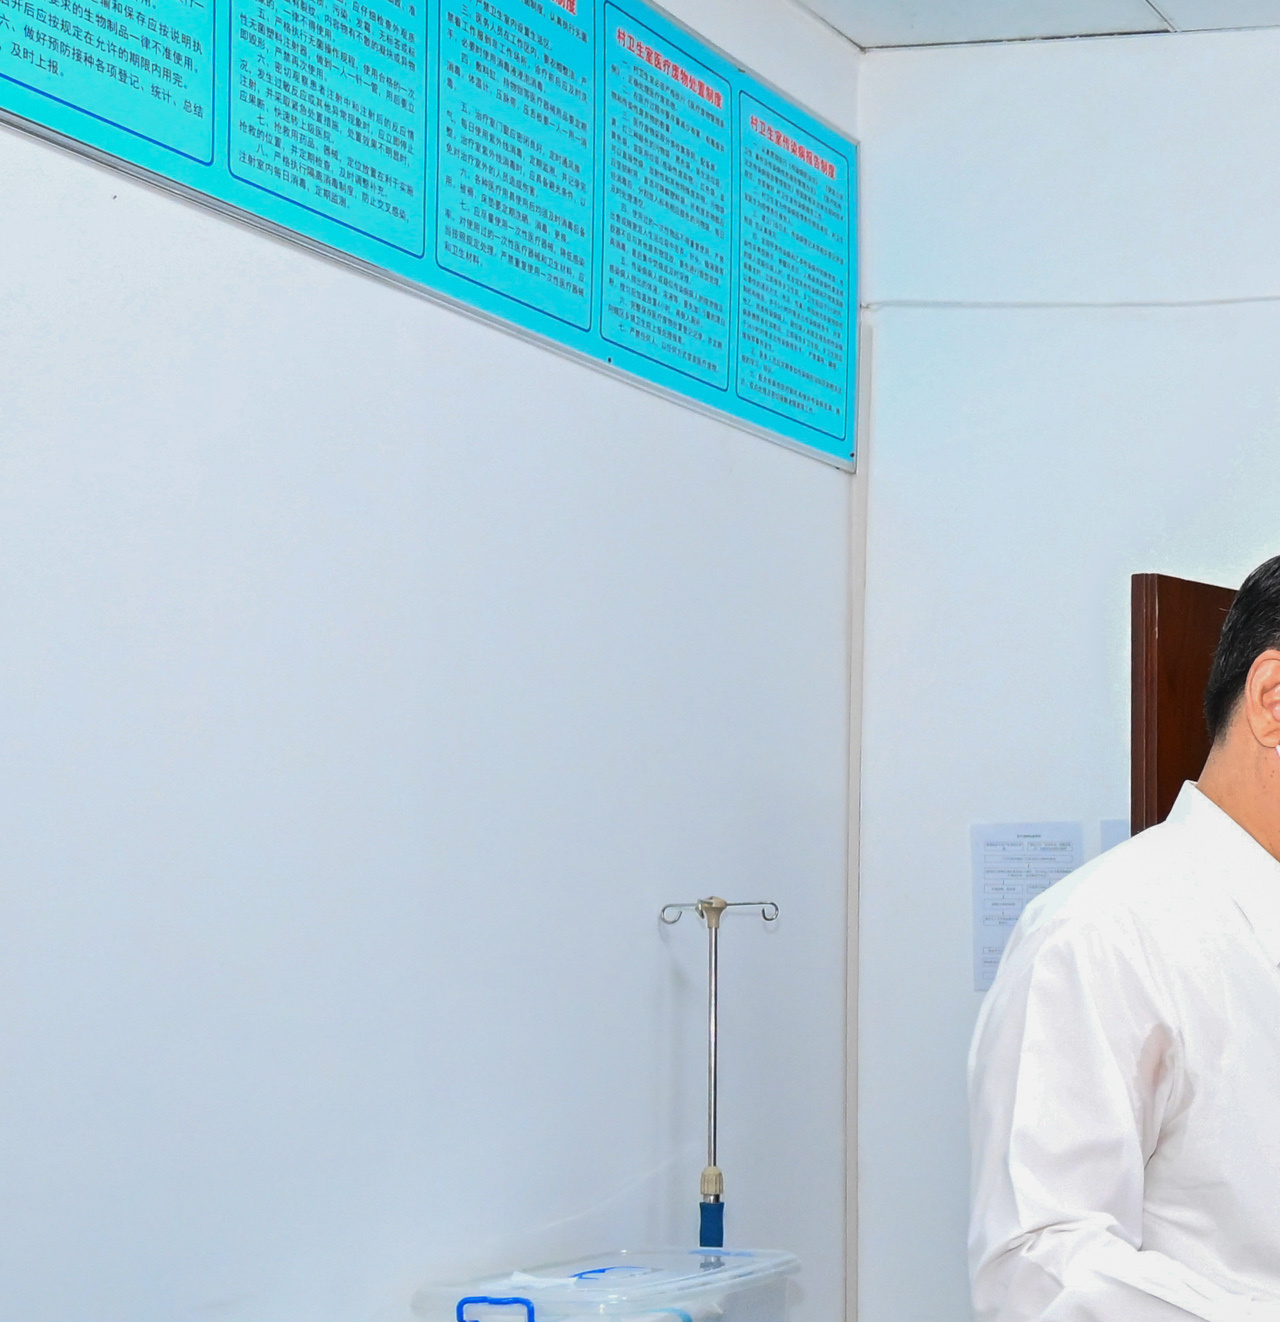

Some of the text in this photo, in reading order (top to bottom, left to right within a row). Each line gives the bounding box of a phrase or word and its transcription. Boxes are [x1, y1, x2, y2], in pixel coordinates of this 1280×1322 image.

[617, 26, 722, 110] 村卫生室医疗废物处置制度
[750, 113, 835, 181] 村卫生室传染病报告制度
